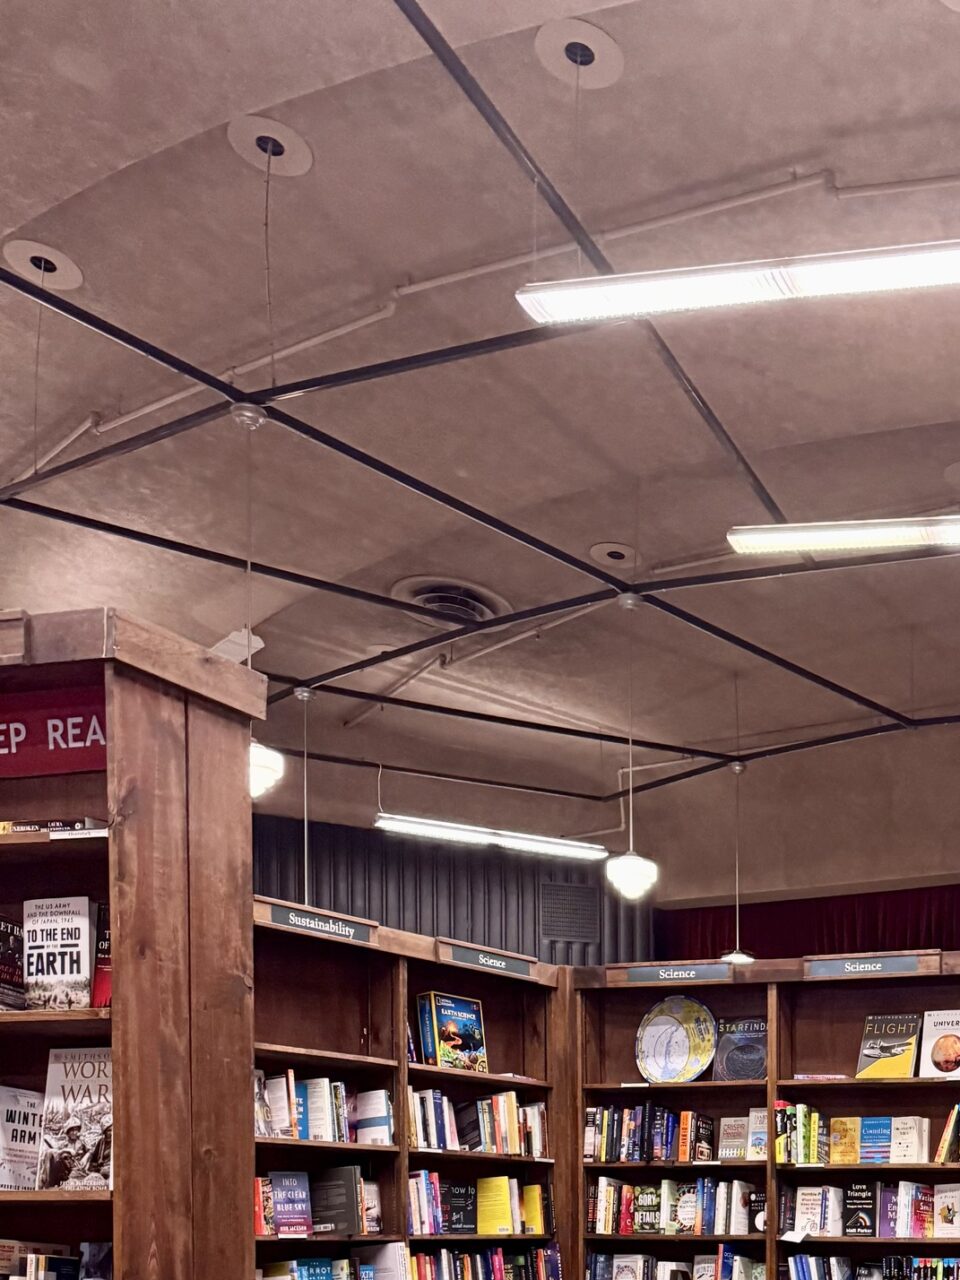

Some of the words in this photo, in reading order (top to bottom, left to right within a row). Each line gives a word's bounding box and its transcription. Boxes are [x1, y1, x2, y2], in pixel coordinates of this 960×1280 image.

[288, 912, 354, 940] Sustainability
[27, 929, 37, 943] TO
[40, 928, 58, 941] THE
[61, 927, 81, 940] END
[27, 951, 81, 977] EARTH
[478, 954, 507, 968] Science
[845, 962, 882, 972] Science
[659, 969, 696, 978] Science
[865, 1023, 916, 1034] FLIGHT
[61, 1084, 111, 1103] WAR
[282, 1178, 297, 1186] INTO
